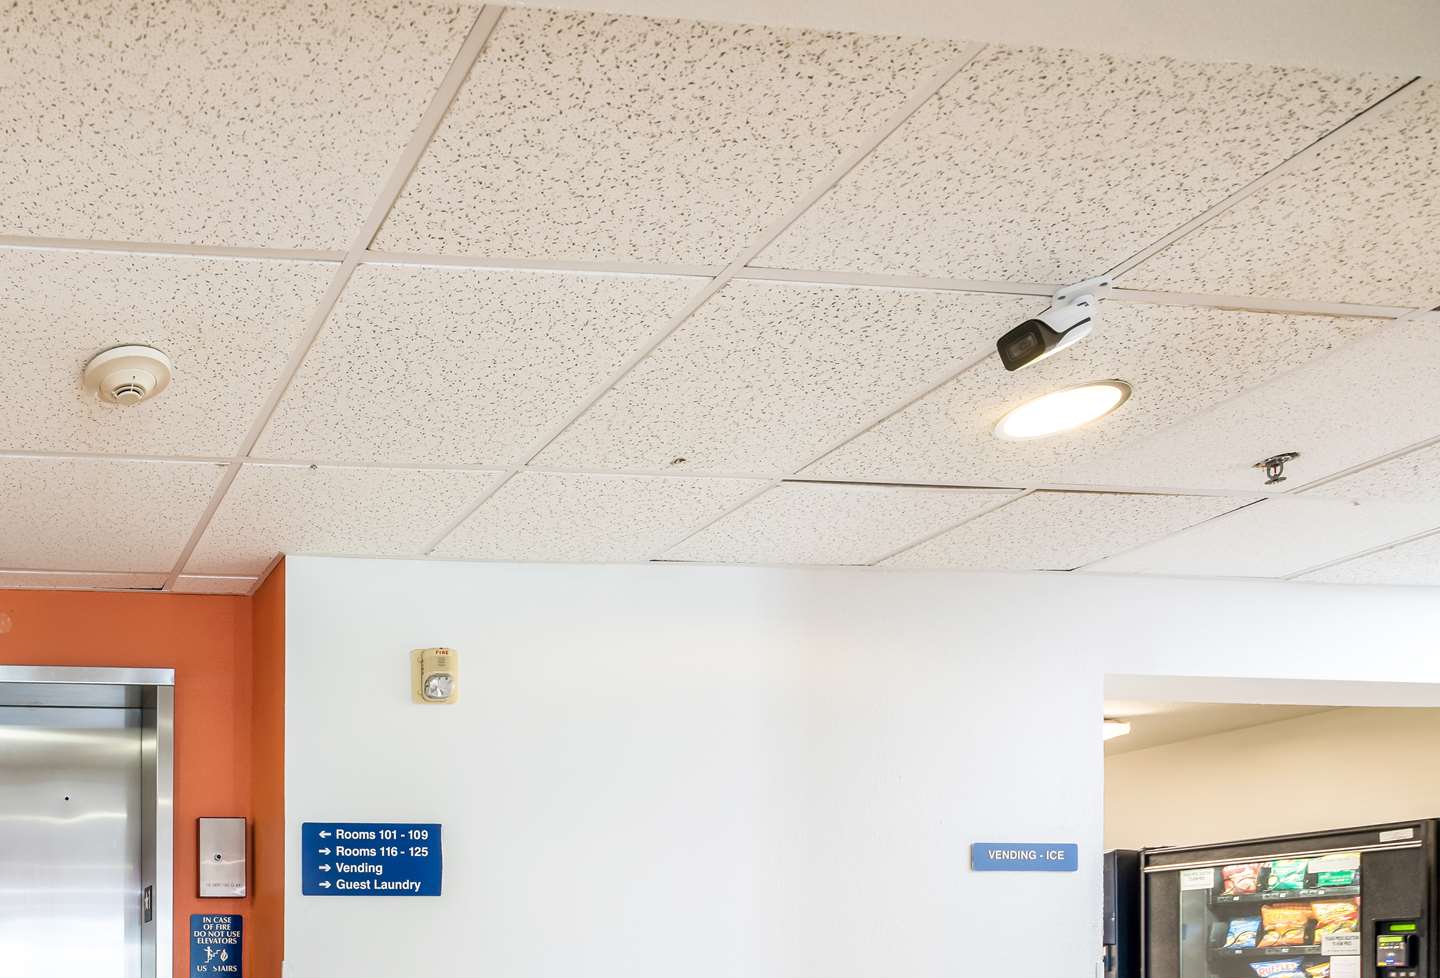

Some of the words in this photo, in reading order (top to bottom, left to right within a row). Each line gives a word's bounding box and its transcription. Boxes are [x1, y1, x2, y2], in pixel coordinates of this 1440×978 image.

[335, 829, 376, 840] Rooms
[379, 829, 397, 840] 101
[408, 830, 429, 840] 109
[335, 846, 377, 857] Rooms
[379, 846, 398, 857] 116
[408, 847, 429, 857] 125
[988, 850, 1037, 860] VENDING
[1046, 850, 1065, 860] ICE
[335, 862, 383, 875] Vending
[335, 879, 371, 890] Guest
[374, 880, 422, 892] Laundry
